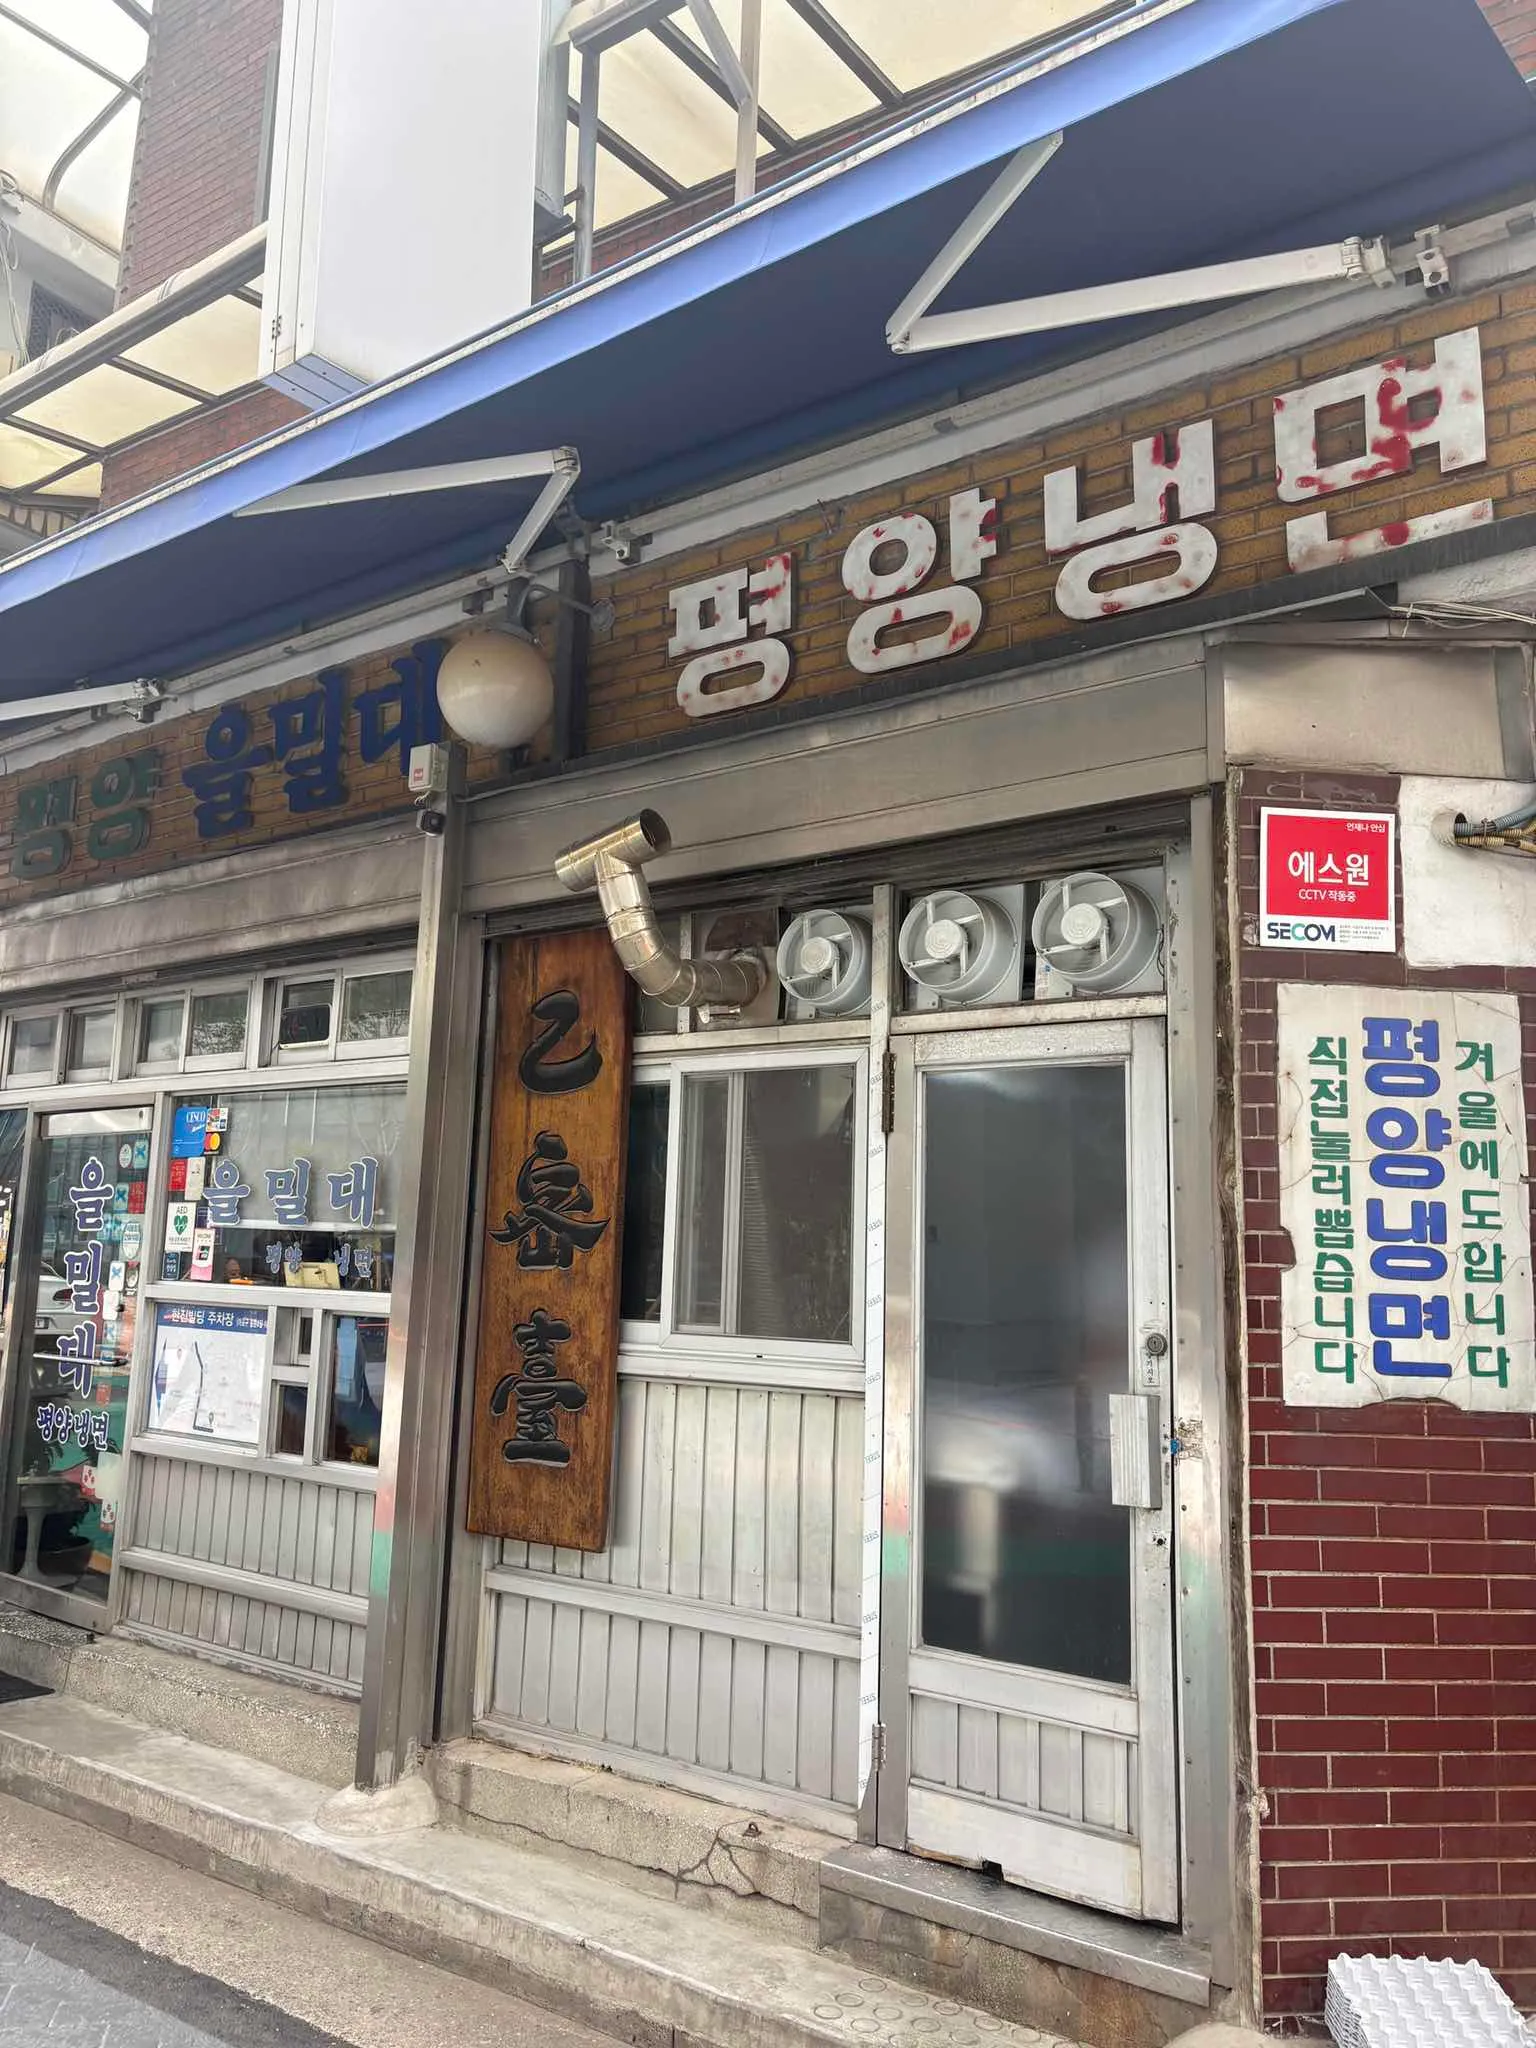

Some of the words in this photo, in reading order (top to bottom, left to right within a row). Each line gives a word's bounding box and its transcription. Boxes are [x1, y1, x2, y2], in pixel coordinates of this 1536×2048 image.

[667, 326, 1493, 719] 평양냉면
[182, 637, 448, 839] 을밀대
[1346, 822, 1369, 832] 언제나
[1370, 823, 1385, 833] 안심
[1287, 850, 1369, 886] 에스원
[1298, 888, 1327, 900] CCTV
[1328, 890, 1357, 903] 작동중
[1267, 922, 1336, 942] SECOM
[176, 1205, 188, 1215] AED
[202, 1156, 379, 1229] 을밀대
[1362, 1017, 1453, 1379] 평양냉면
[265, 1240, 303, 1275] 평양
[57, 1156, 114, 1399] 을밀대
[207, 1311, 235, 1328] 주차장
[36, 1402, 109, 1451] 평양냉면
